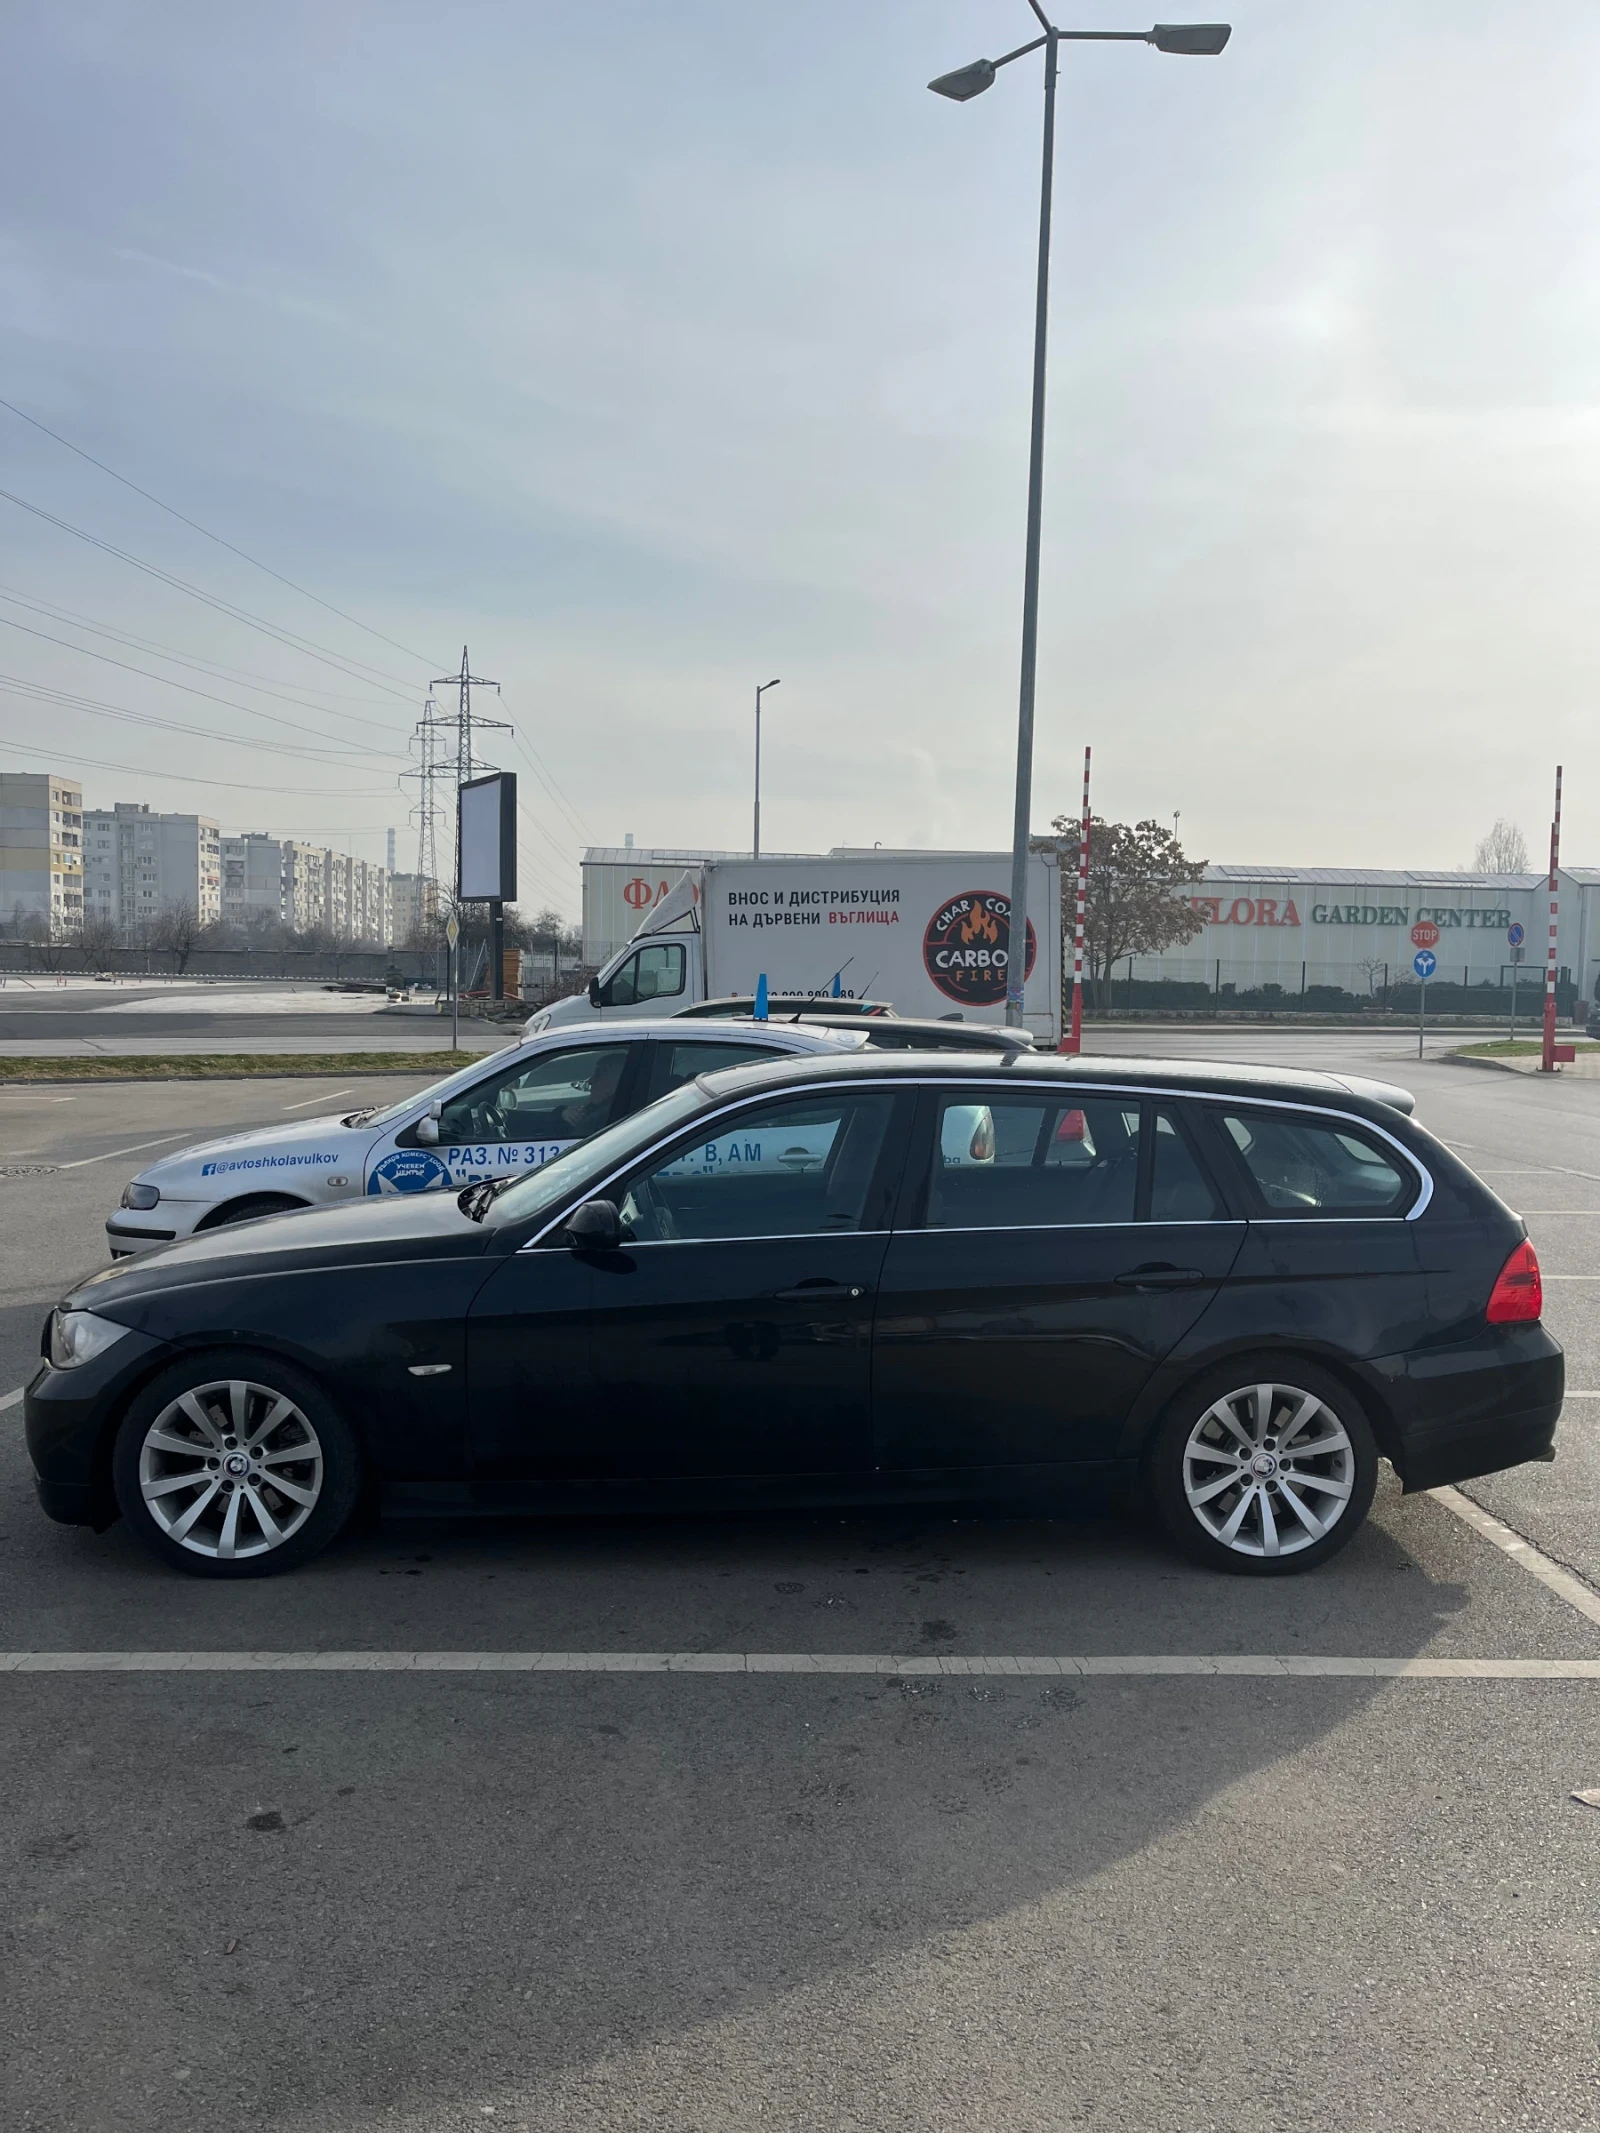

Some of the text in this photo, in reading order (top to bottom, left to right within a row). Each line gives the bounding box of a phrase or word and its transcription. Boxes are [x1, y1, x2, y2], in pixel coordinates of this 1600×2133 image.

[728, 890, 900, 907] ВНОС И ДИСТРИБУЦИЯ
[728, 911, 900, 928] НА ДЪРВЕНИ ВЪГЛИЩА
[936, 900, 970, 931] CHAR
[1312, 904, 1410, 926] GARDEN
[1416, 907, 1512, 928] CENTER
[1412, 929, 1438, 941] STOP
[935, 949, 1009, 968] CARBO
[956, 970, 1006, 981] FIRE
